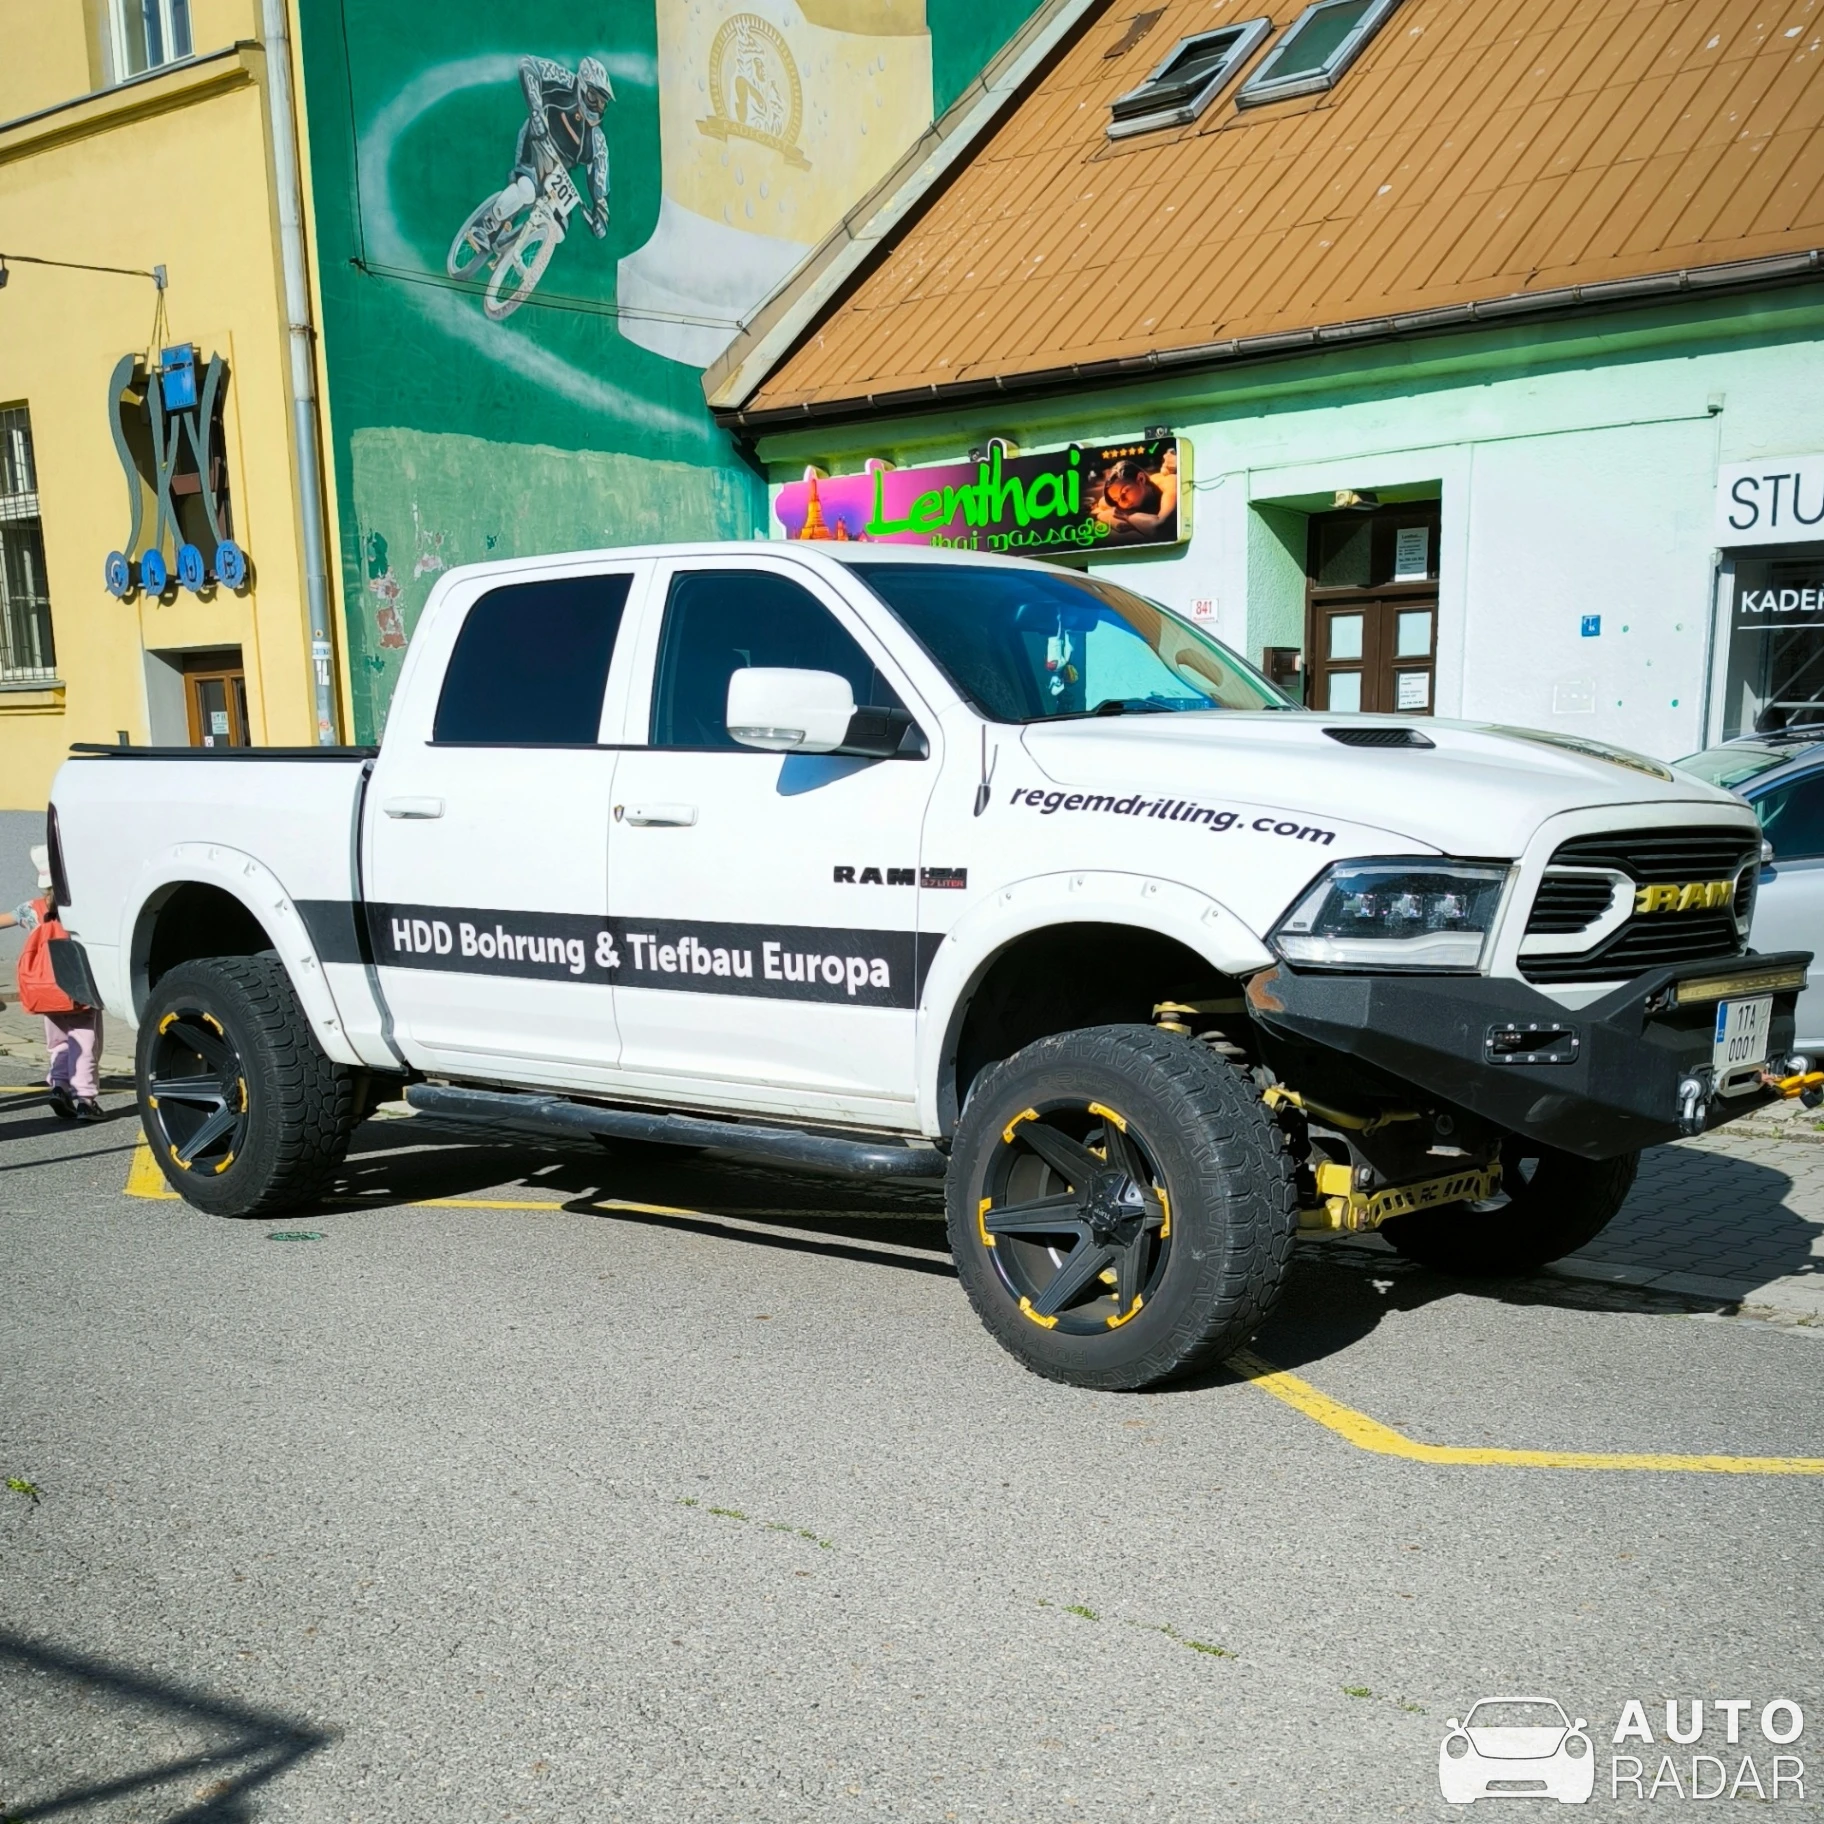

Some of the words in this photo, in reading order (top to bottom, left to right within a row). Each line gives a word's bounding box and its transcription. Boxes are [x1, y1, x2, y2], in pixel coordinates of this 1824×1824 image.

[550, 174, 574, 208] 201
[865, 445, 1081, 536] Lenthai
[1729, 473, 1824, 530] STU
[987, 517, 1111, 553] massage
[1196, 601, 1212, 615] 841
[833, 866, 916, 886] RAM
[1635, 881, 1734, 914] RAM
[391, 918, 453, 955] HDD
[459, 922, 586, 975] Bohrung
[594, 931, 621, 968] &
[626, 933, 753, 978] Tiefbau
[762, 941, 890, 996] Europa
[1738, 1004, 1756, 1031] 1TA
[1729, 1035, 1756, 1062] 0001
